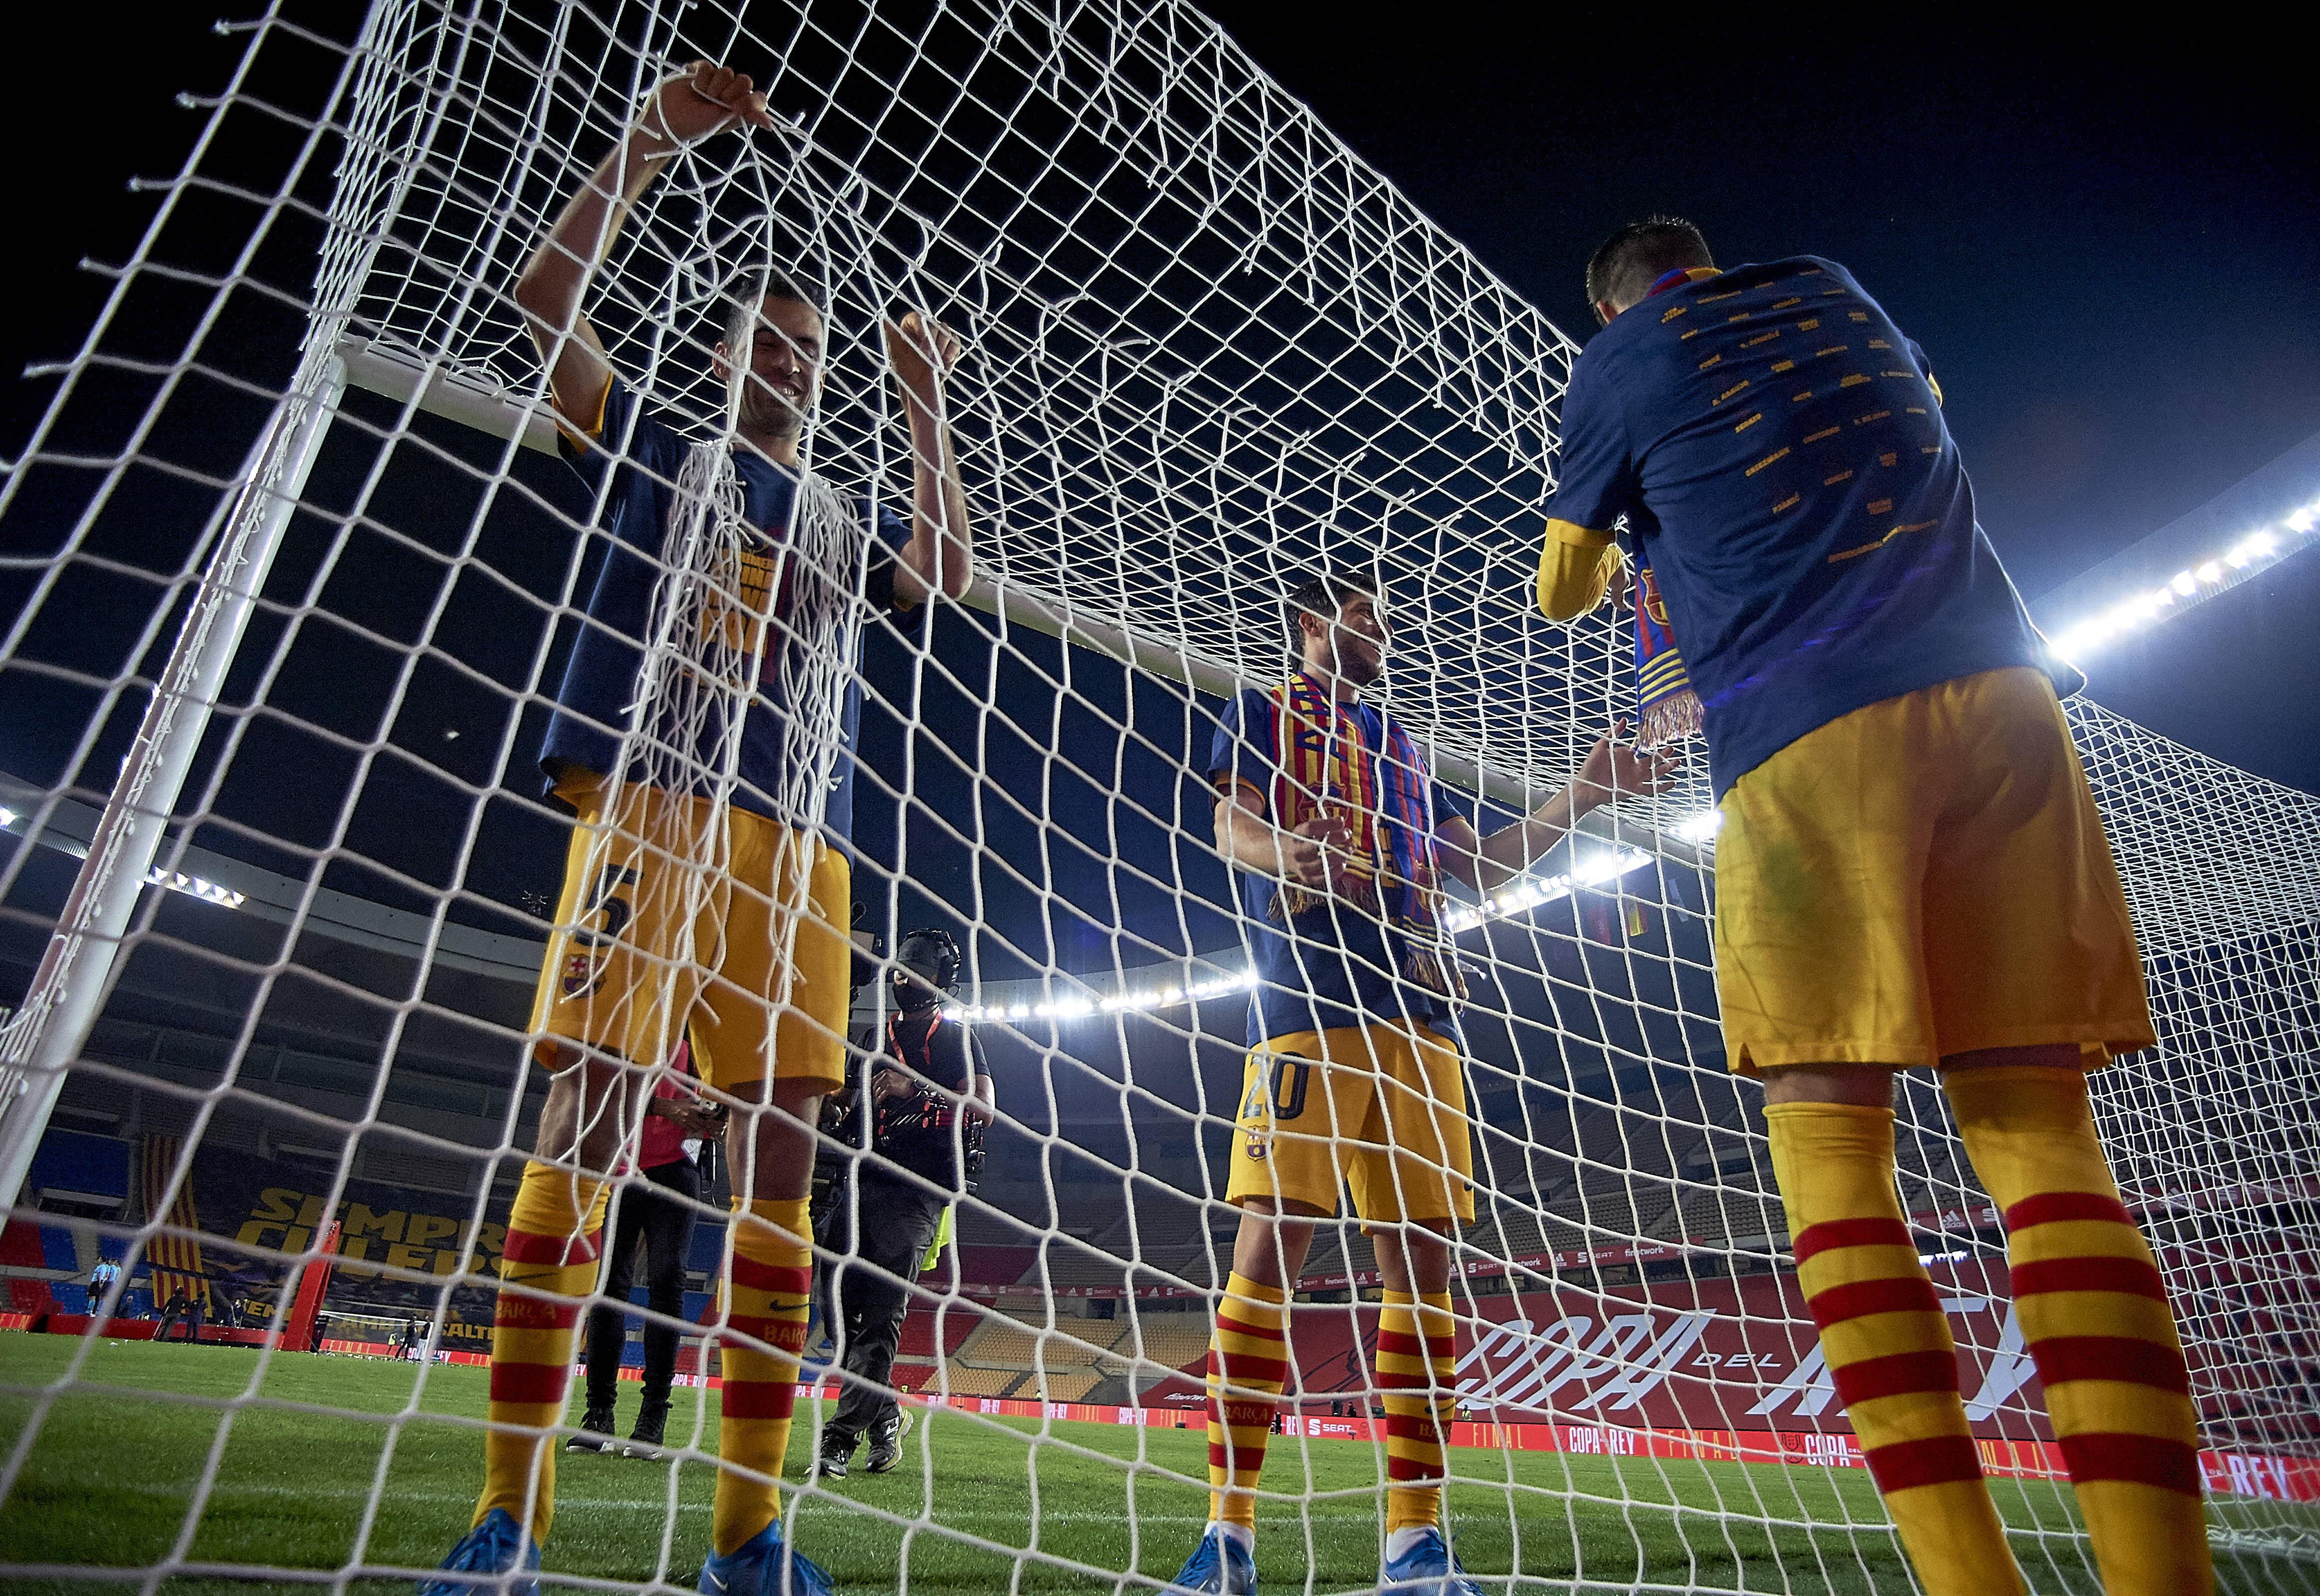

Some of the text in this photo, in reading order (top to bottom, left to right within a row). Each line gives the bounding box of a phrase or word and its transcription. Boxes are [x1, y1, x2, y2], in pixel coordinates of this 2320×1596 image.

[575, 863, 644, 947] 5
[1243, 1051, 1310, 1120] 20
[1455, 1308, 1717, 1410] COPA
[1691, 1353, 1781, 1368] DEL
[671, 1373, 687, 1387] OPA
[1322, 1423, 1352, 1432] SEAT
[1473, 1423, 1523, 1449] FINAL
[1569, 1426, 1634, 1455] COPA REY
[1668, 1429, 1737, 1460] FINAL
[1804, 1434, 1851, 1467] COPA
[2227, 1455, 2291, 1499] REY
